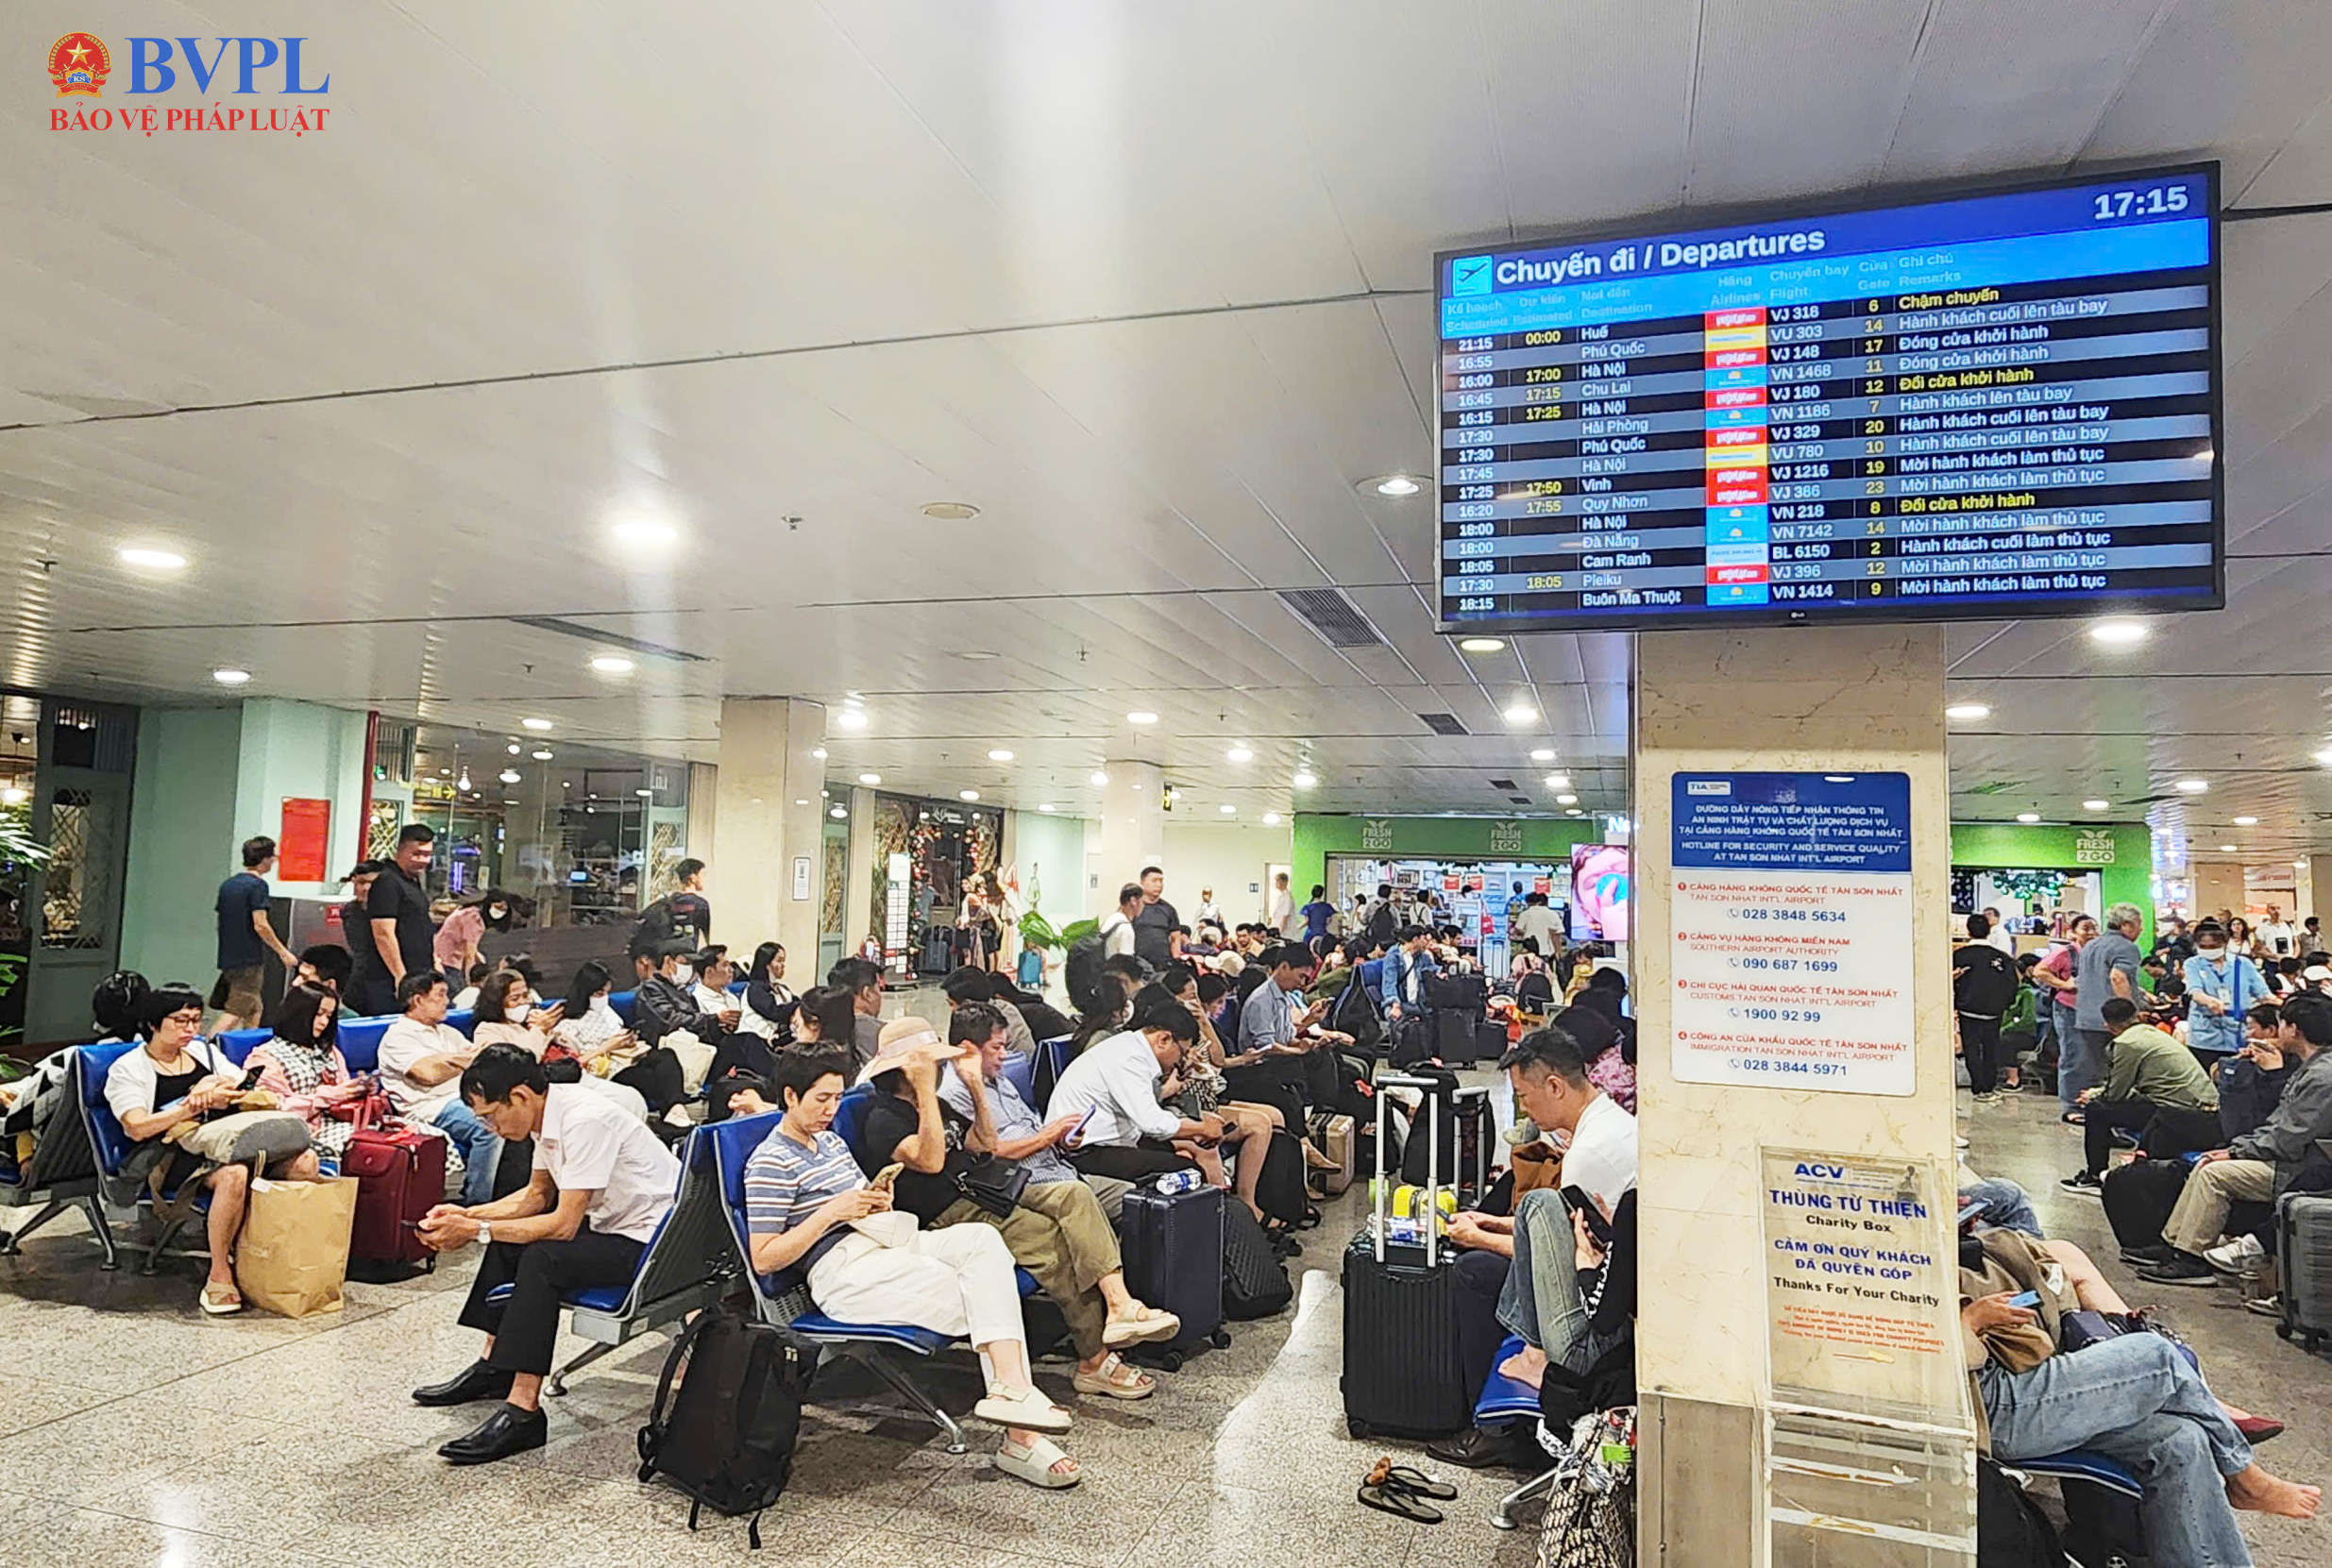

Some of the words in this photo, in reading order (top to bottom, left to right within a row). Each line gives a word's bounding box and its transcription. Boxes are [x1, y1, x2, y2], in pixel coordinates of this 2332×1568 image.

[2095, 186, 2188, 220] 17:15
[1496, 251, 1601, 285] Chuyến
[1609, 246, 1635, 273] đi
[1644, 245, 1653, 269] /
[1661, 230, 1825, 268] Departures
[1458, 336, 1493, 352] 21:15
[1525, 329, 1561, 346] 00:00
[1581, 325, 1608, 340] Huế
[1770, 308, 1789, 322] VJ
[1792, 305, 1819, 320] 318
[1868, 298, 1879, 312] 6
[1899, 293, 1942, 312] Chậm
[1946, 287, 1999, 308] chuyến
[1458, 355, 1493, 370] 16:55
[1770, 327, 1792, 342] VU
[1796, 324, 1822, 340] 303
[1864, 318, 1884, 333] 14
[1458, 374, 1493, 389] 16:00
[1525, 367, 1561, 383] 17:00
[1581, 364, 1600, 378] Hà
[1603, 362, 1626, 379] Nội
[1770, 347, 1789, 362] VJ
[1792, 345, 1819, 360] 148
[1864, 339, 1884, 353] 17
[1458, 393, 1493, 407] 16:45
[1525, 386, 1562, 402] 17:15
[1581, 382, 1609, 397] Chu
[1612, 380, 1631, 395] Lai
[1770, 366, 1793, 381] VN
[1797, 363, 1831, 379] 1468
[1865, 359, 1884, 374] 11
[1459, 411, 1493, 426] 16:15
[1525, 405, 1562, 420] 17:25
[1581, 402, 1601, 416] Hà
[1604, 400, 1626, 416] Nội
[1770, 387, 1790, 401] VJ
[1793, 384, 1819, 399] 180
[1865, 379, 1884, 394] 12
[1459, 430, 1494, 445] 17:30
[1770, 406, 1793, 421] VN
[1798, 403, 1830, 419] 1186
[1868, 399, 1880, 413] 7
[1459, 448, 1494, 463] 17:30
[1771, 427, 1790, 441] VJ
[1793, 424, 1819, 439] 329
[1865, 419, 1884, 434] 20
[1900, 415, 1938, 431] Hành
[1942, 413, 1986, 429] khách
[1990, 410, 2021, 425] cuối
[2024, 408, 2047, 423] lên
[2052, 406, 2076, 421] tàu
[2079, 403, 2109, 422] bay
[1459, 467, 1494, 481] 17:45
[1771, 447, 1793, 461] VU
[1797, 444, 1823, 459] 780
[1865, 440, 1884, 454] 10
[1459, 485, 1494, 500] 17:25
[1581, 478, 1611, 492] Vinh
[1771, 466, 1790, 481] VJ
[1794, 464, 1829, 479] 1216
[1865, 460, 1884, 475] 19
[1900, 457, 1928, 472] Mời
[1932, 455, 1969, 470] hành
[1972, 451, 2017, 467] khách
[2020, 449, 2048, 464] làm
[2052, 447, 2076, 463] thủ
[2079, 446, 2104, 464] tục
[1459, 504, 1494, 518] 16:20
[1526, 500, 1562, 514] 17:55
[1771, 486, 1790, 500] VJ
[1793, 484, 1820, 498] 386
[1865, 481, 1884, 495] 23
[1459, 523, 1494, 537] 18:00
[1582, 516, 1601, 531] Hà
[1604, 515, 1626, 531] Nội
[1771, 506, 1794, 520] VN
[1798, 504, 1824, 518] 218
[1869, 501, 1880, 514] 8
[1459, 542, 1494, 555] 18:00
[1771, 526, 1794, 540] VN
[1798, 524, 1833, 538] 7142
[1866, 521, 1884, 535] 14
[1459, 560, 1494, 574] 18:05
[1582, 554, 1613, 568] Cam
[1616, 552, 1651, 566] Ranh
[1772, 546, 1792, 560] BL
[1795, 544, 1830, 559] 6150
[1869, 541, 1881, 555] 2
[1459, 579, 1494, 593] 17:30
[1526, 576, 1563, 590] 18:05
[1582, 573, 1621, 587] Pleiku
[1772, 565, 1791, 580] VJ
[1794, 565, 1820, 579] 396
[1866, 562, 1885, 575] 12
[1460, 598, 1494, 611] 18:15
[1772, 585, 1794, 599] VN
[1799, 583, 1833, 599] 1414
[1870, 582, 1881, 596] 9
[1681, 841, 1720, 850] HOTLINE
[1743, 842, 1790, 851] SECURITY
[1792, 843, 1813, 851] AND
[1814, 844, 1856, 852] SERVICE
[1858, 845, 1900, 853] QUALITY
[2076, 839, 2114, 850] FRESH
[2079, 851, 2113, 861] 2GO
[1743, 908, 1767, 919] 028
[1772, 909, 1806, 920] 3848
[1812, 911, 1846, 922] 5634
[1743, 958, 1768, 969] 090
[1772, 959, 1798, 970] 687
[1803, 960, 1837, 971] 1699
[1785, 947, 1839, 955] AUTHORITY
[1744, 1008, 1777, 1020] 1900
[1782, 1010, 1799, 1020] 92
[1803, 1011, 1820, 1022] 99
[1744, 1059, 1768, 1071] 028
[1774, 1061, 1808, 1072] 3844
[1814, 1064, 1847, 1075] 5971
[1795, 1163, 1844, 1178] ACV
[1769, 1189, 1832, 1208] THÙNG
[1837, 1194, 1863, 1211] TỪ
[1868, 1200, 1927, 1220] THIỆN
[1806, 1215, 1857, 1230] Charity
[1864, 1221, 1891, 1232] Box
[1774, 1237, 1807, 1252] CẢM
[1814, 1243, 1833, 1255] ƠN
[1839, 1246, 1869, 1258] QUÝ
[1877, 1251, 1932, 1265] KHÁCH
[1796, 1258, 1816, 1270] ĐÃ
[1822, 1261, 1874, 1276] QUYÊN
[1881, 1269, 1912, 1280] GÓP
[1774, 1277, 1821, 1291] Thanks
[1827, 1283, 1849, 1295] For
[1853, 1286, 1884, 1299] Your
[1890, 1290, 1939, 1307] Charity
